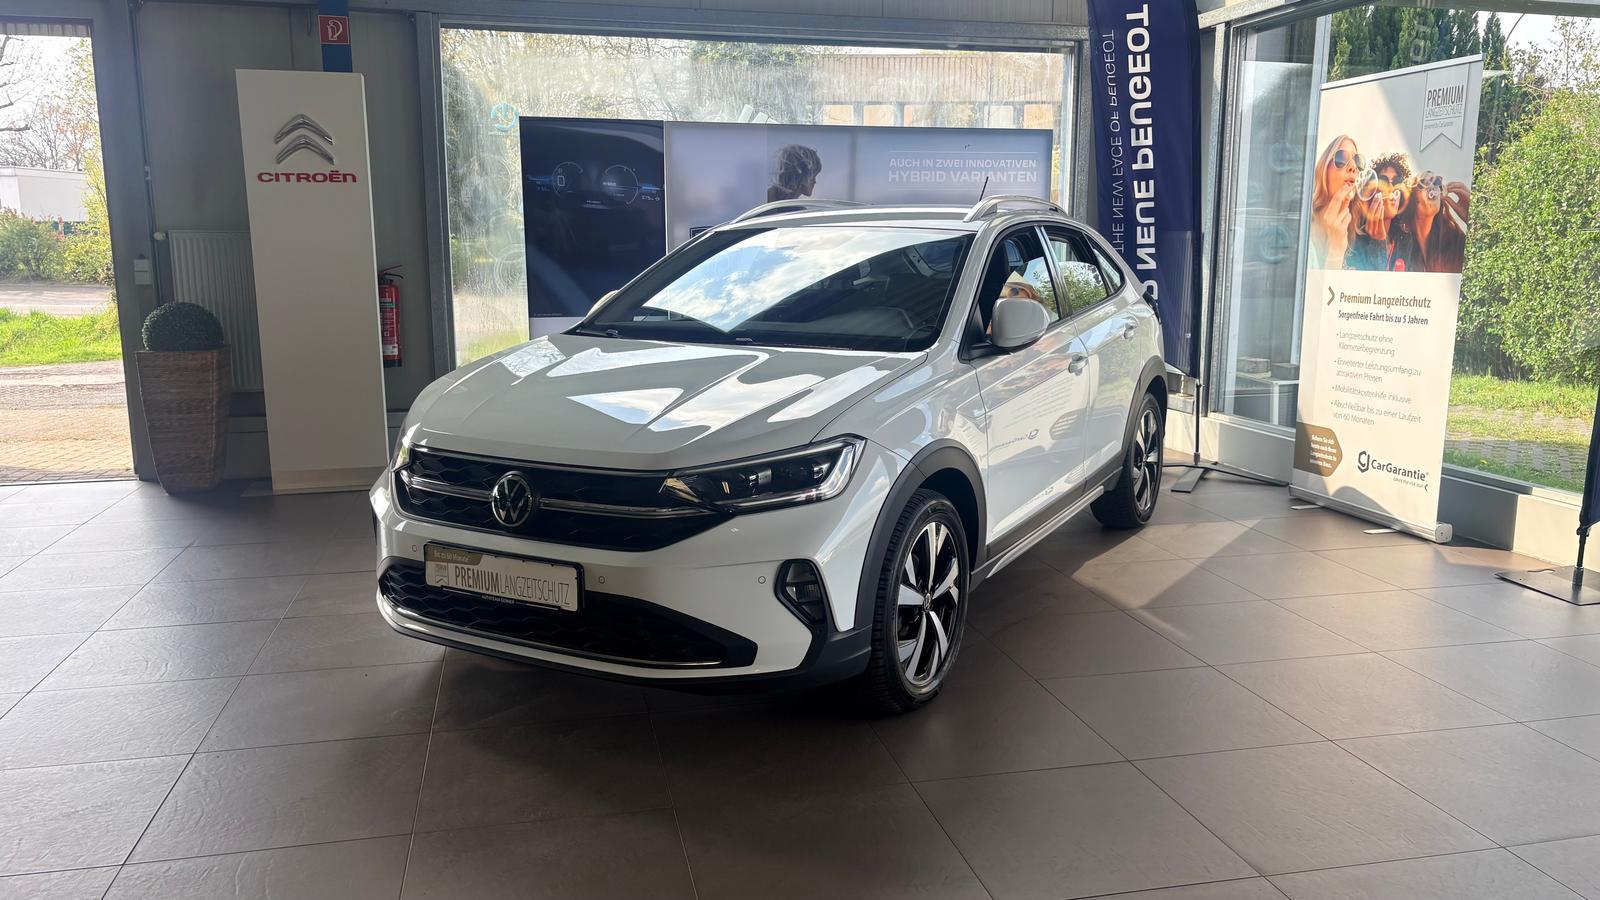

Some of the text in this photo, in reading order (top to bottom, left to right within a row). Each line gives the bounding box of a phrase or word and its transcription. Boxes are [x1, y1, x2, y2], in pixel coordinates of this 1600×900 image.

[1426, 84, 1464, 108] PREMIUM
[889, 158, 1037, 168] AUCH IN ZWEI INNOVATIVEN
[888, 170, 1037, 183] HYBRID VARIANTEN
[1339, 292, 1431, 309] Premium Langzeitschutz
[1338, 310, 1429, 326] Sorgenfreie Fahrt bis zu 5 Jahren
[1378, 334, 1394, 344] ohne
[1413, 368, 1422, 377] zu
